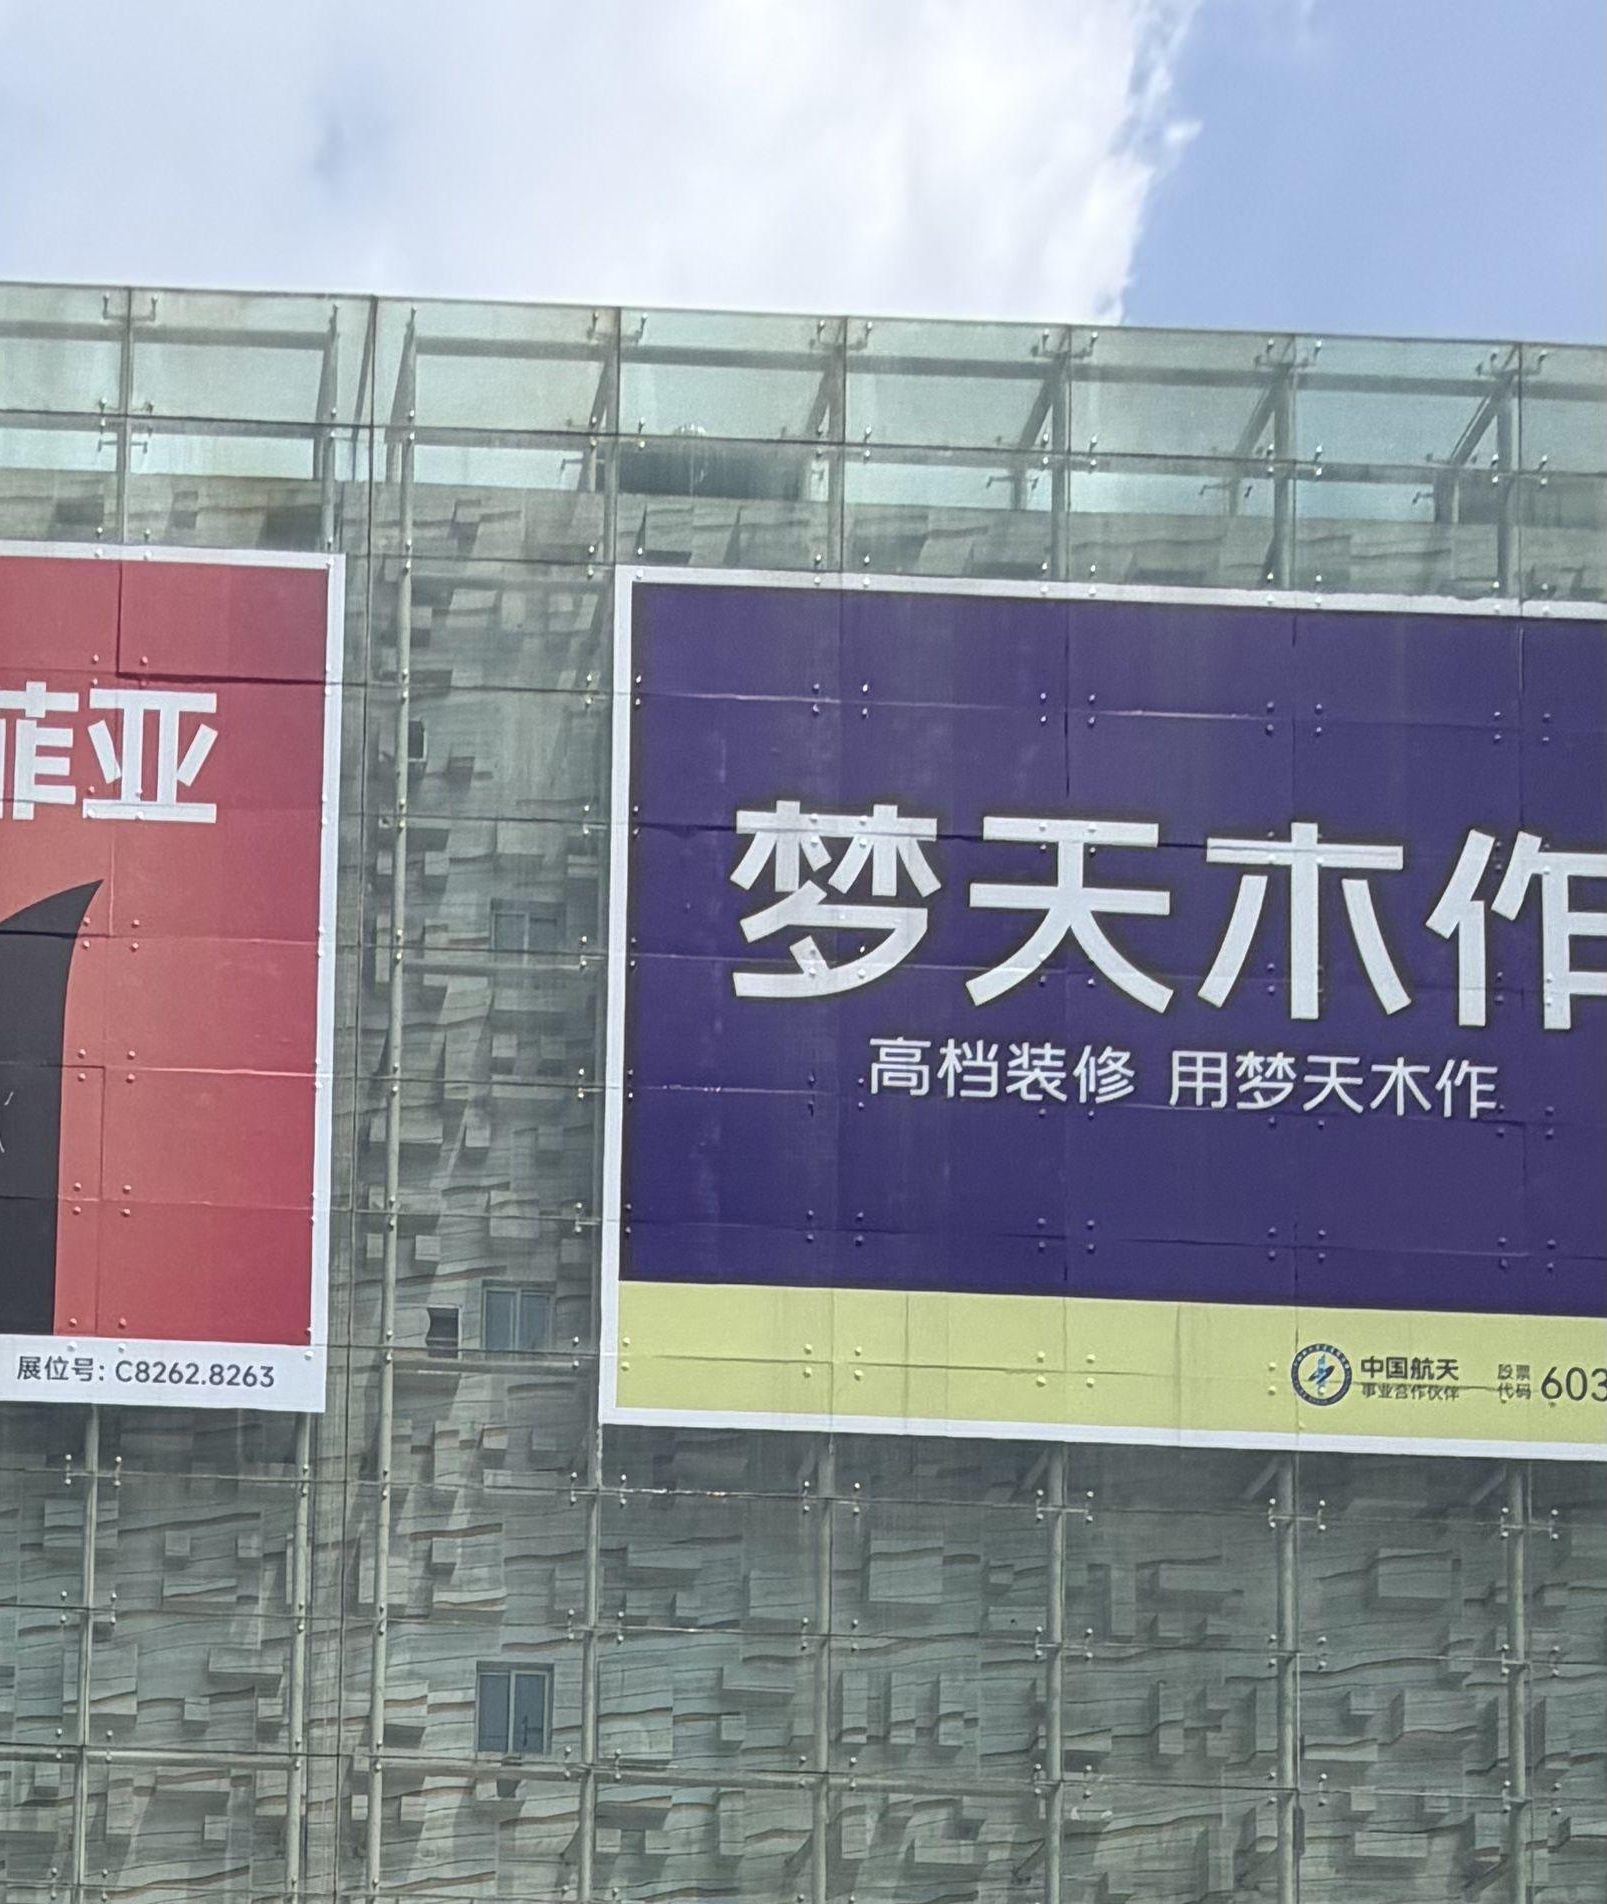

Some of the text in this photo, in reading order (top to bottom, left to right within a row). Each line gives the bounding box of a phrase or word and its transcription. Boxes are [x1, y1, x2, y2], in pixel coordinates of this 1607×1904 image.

[731, 800, 1607, 1030] 梦天木作
[869, 1036, 1499, 1119] 高档装修 用梦天木作
[1360, 1355, 1459, 1381] 中国航天
